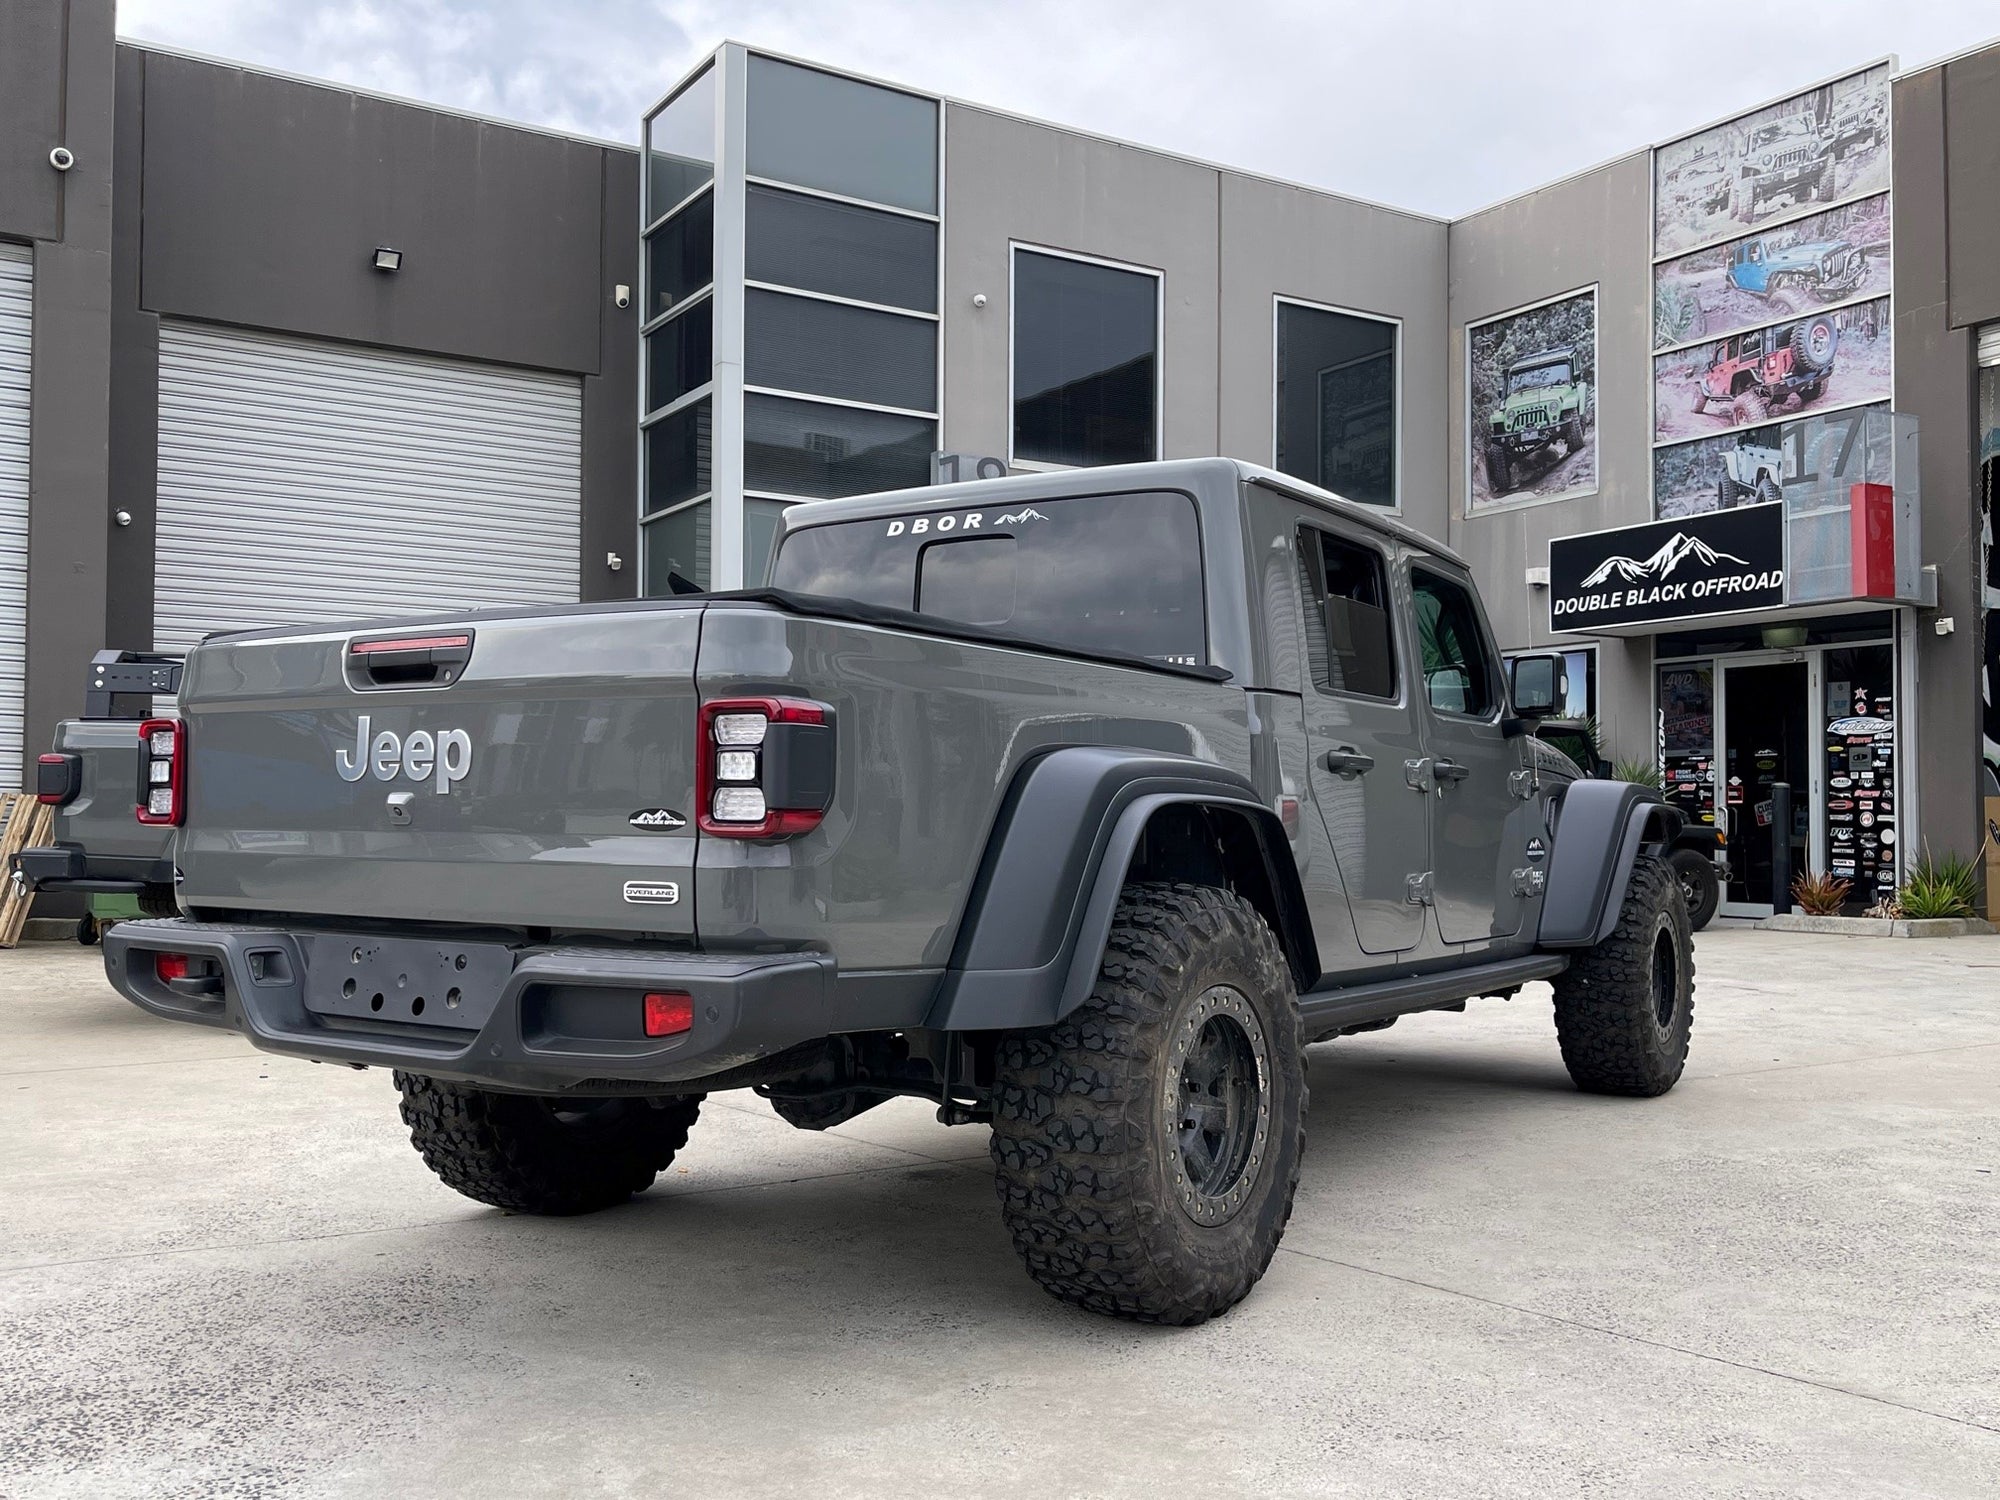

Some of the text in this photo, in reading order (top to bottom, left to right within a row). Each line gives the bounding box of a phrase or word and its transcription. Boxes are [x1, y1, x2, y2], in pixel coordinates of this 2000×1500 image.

[1782, 407, 1865, 487] 17
[886, 513, 983, 537] DBOR
[1554, 570, 1784, 615] DOUBLE BLACK OFFROAD
[336, 715, 472, 795] Jeep
